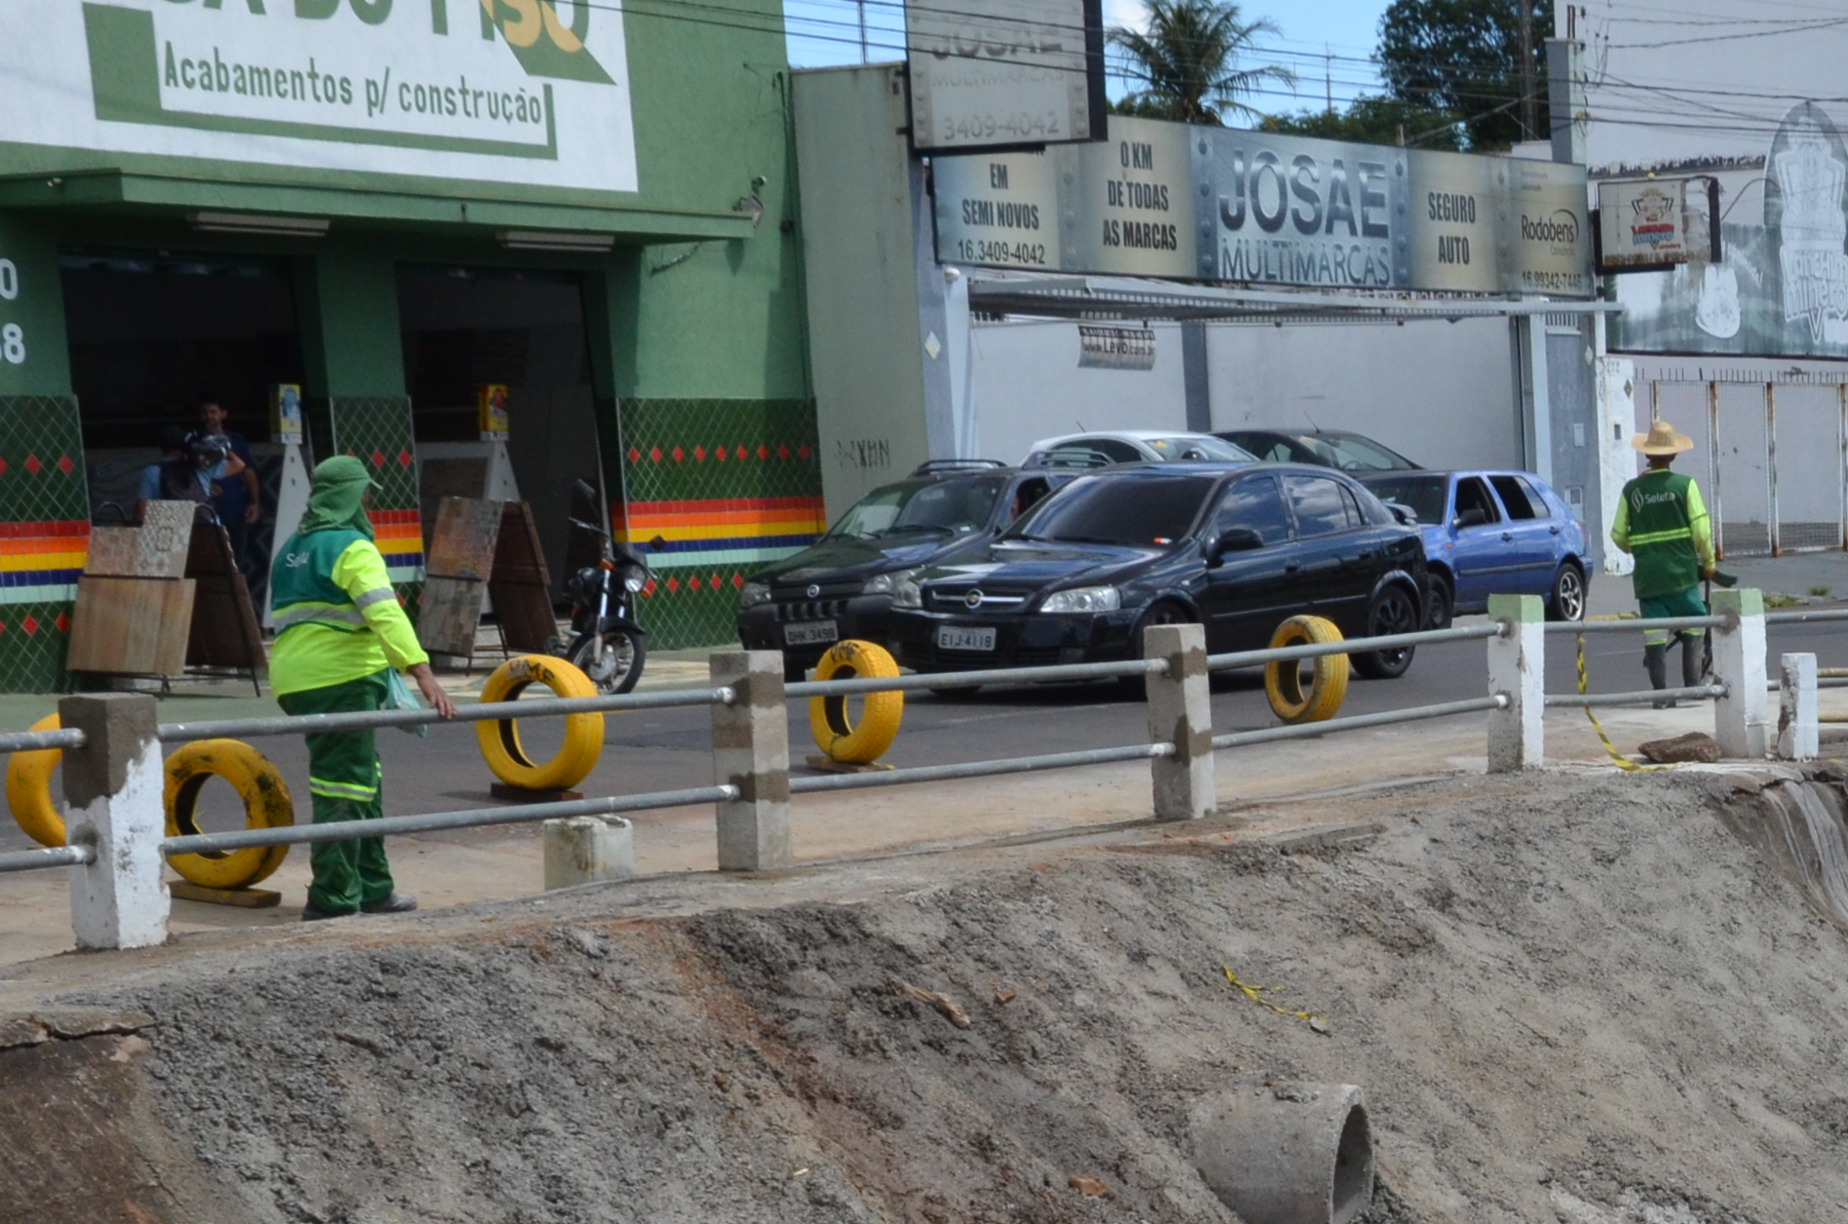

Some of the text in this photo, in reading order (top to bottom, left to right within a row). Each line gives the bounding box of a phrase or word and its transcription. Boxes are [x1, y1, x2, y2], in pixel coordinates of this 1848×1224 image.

[164, 41, 542, 125] Acabamentos p/ construção
[944, 111, 1059, 140] 3409-4042
[1132, 142, 1152, 170] KM
[989, 163, 1008, 190] EM
[1107, 180, 1169, 211] DE TODAS
[1219, 148, 1389, 238] JOSAE
[1428, 191, 1476, 224] SEGURO
[962, 199, 1039, 230] SEMI NOVOS
[1521, 213, 1575, 243] Rodobens
[1102, 220, 1177, 250] AS MARCAS
[1438, 235, 1470, 265] AUTO
[957, 239, 1045, 265] 16.3409-4042
[1220, 238, 1391, 286] MULTIMARCAS
